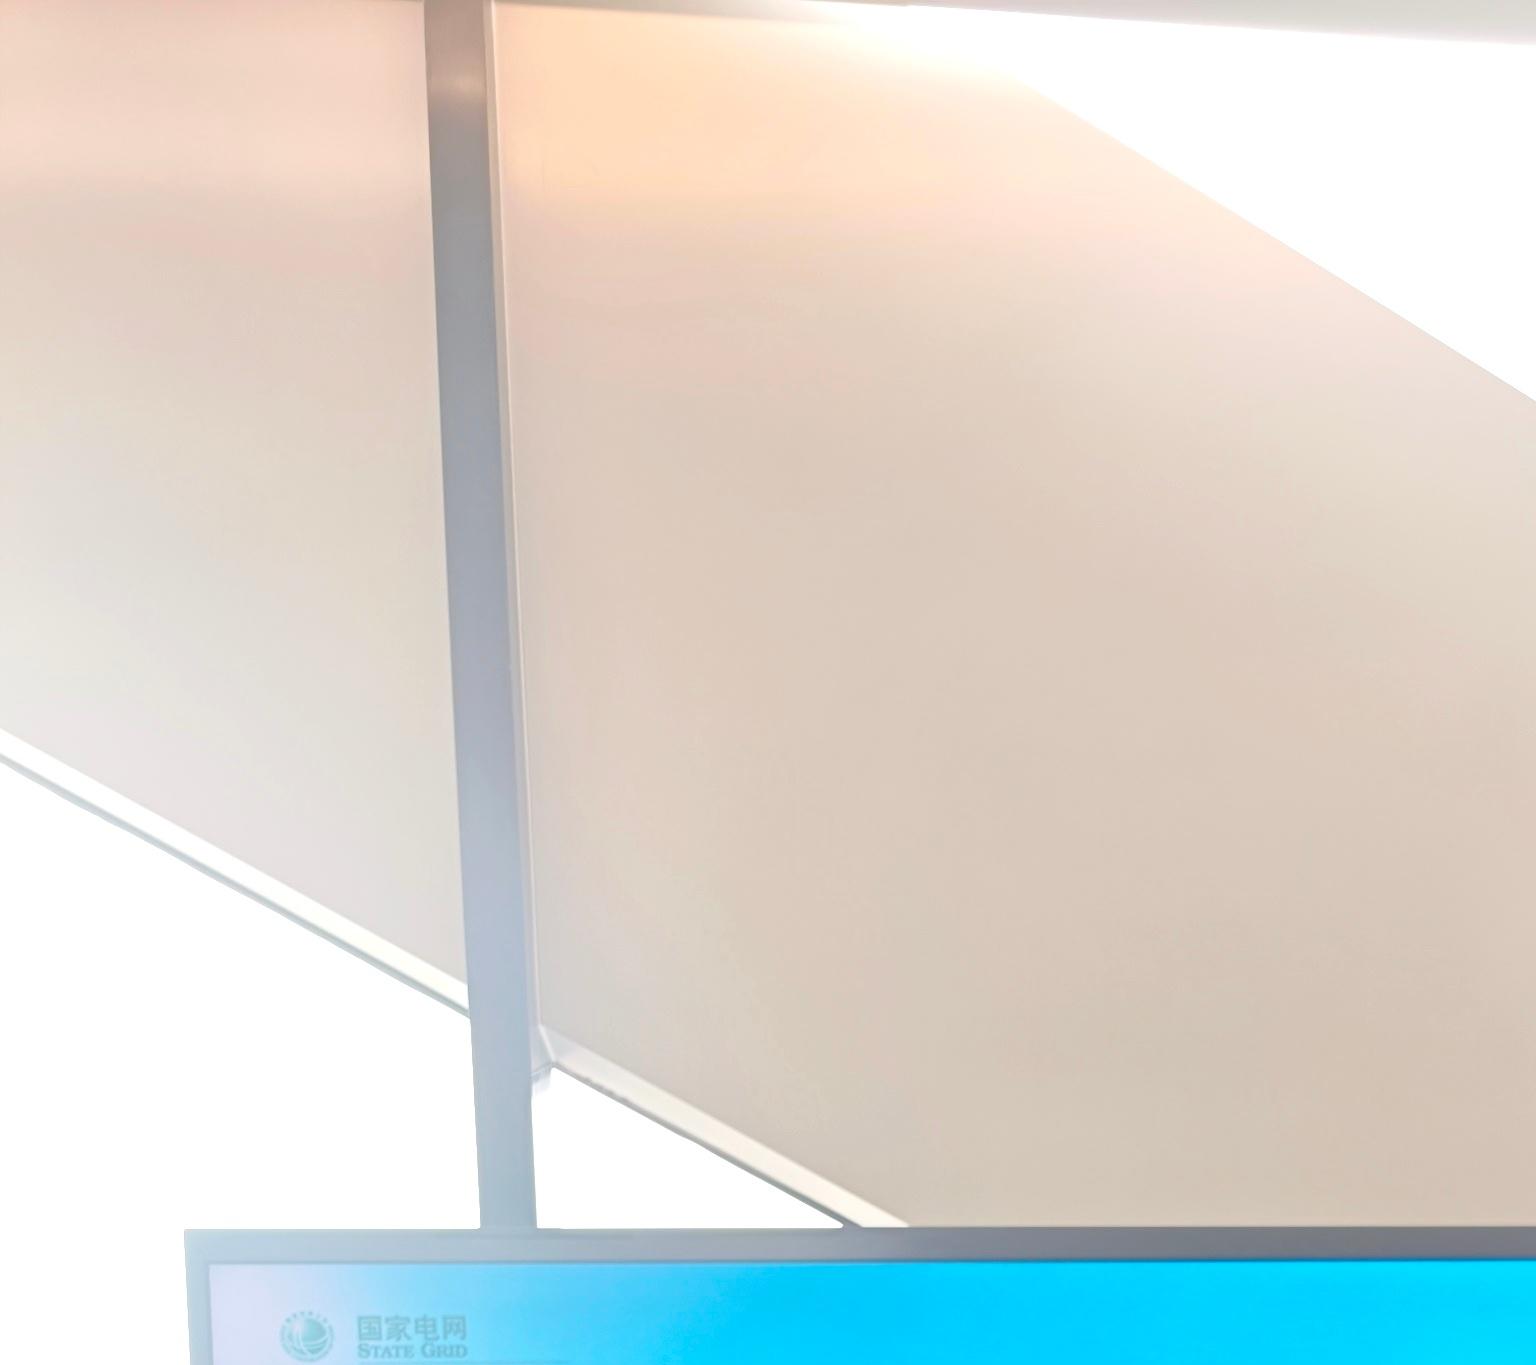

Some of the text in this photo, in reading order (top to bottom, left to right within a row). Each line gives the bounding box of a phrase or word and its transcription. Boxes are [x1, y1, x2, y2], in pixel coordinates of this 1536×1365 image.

[357, 1315, 467, 1341] 国家电网
[357, 1343, 468, 1359] STATE GRID
